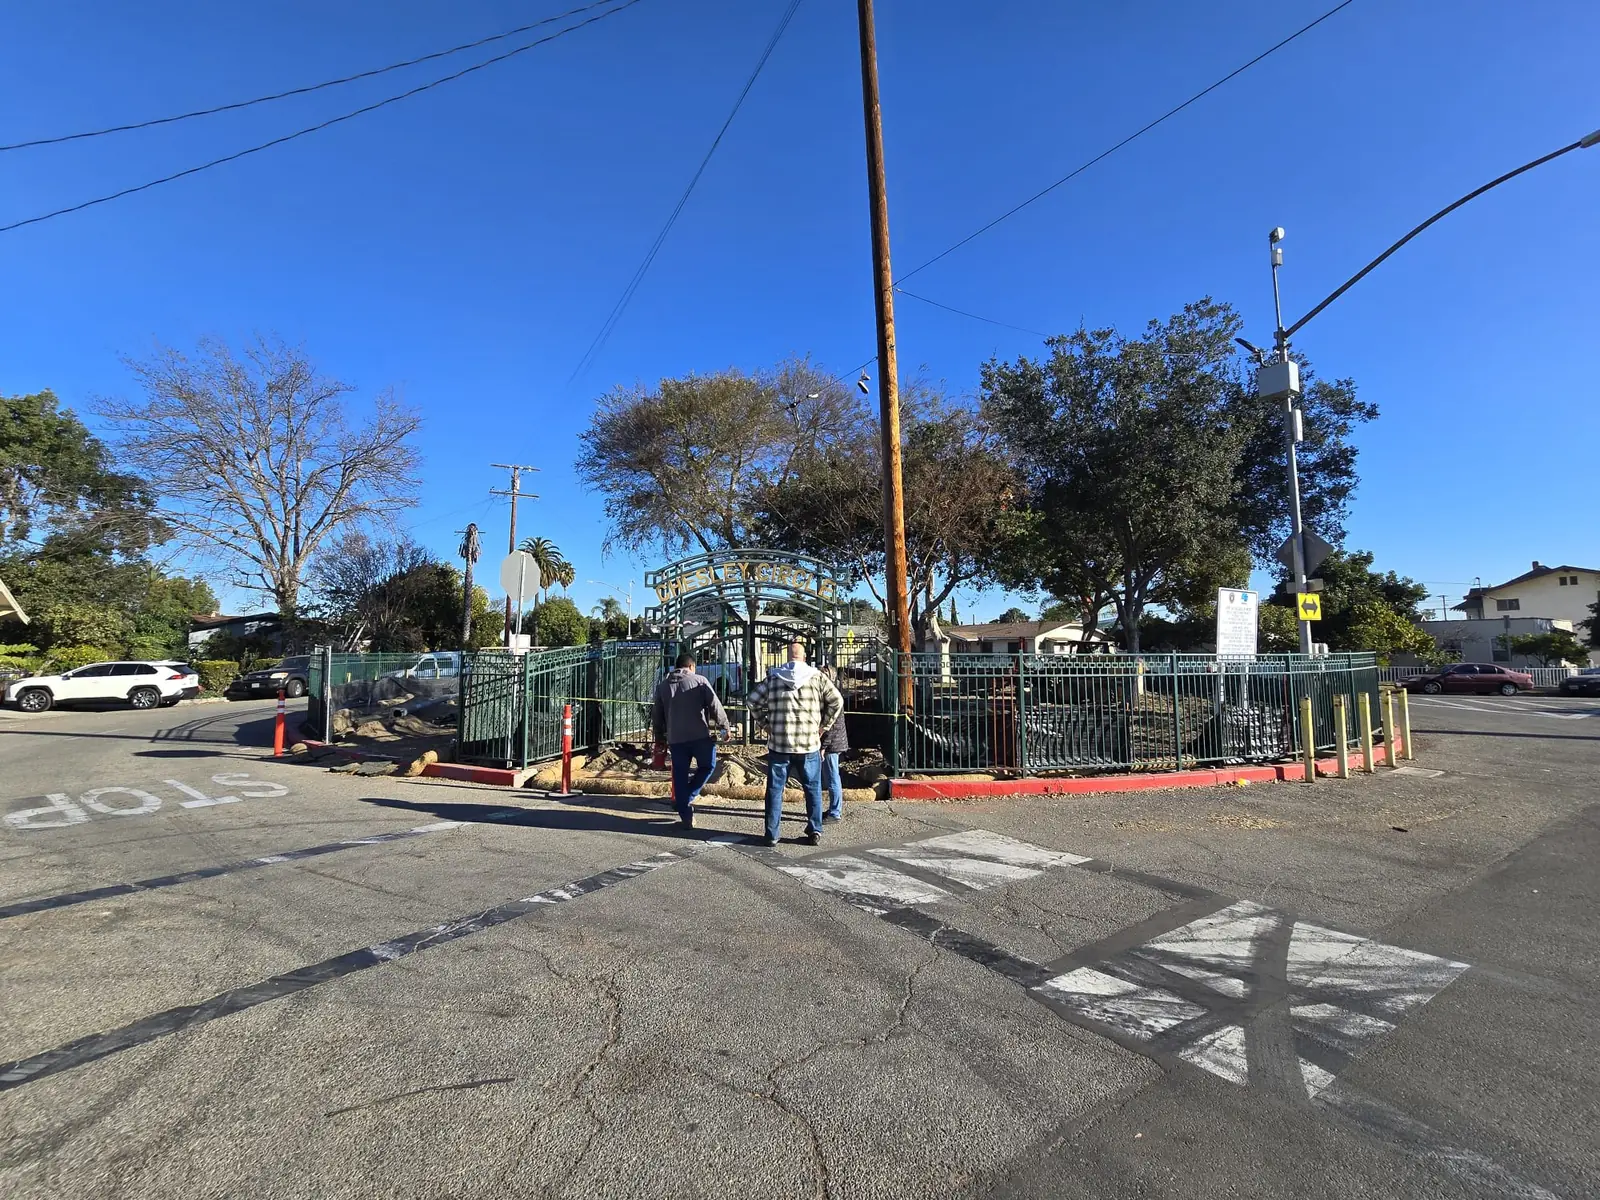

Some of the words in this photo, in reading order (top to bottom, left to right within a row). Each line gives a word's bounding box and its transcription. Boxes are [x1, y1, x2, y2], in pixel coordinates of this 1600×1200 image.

[655, 562, 749, 603] CHESLEY
[756, 562, 836, 601] CIRCLE
[2, 772, 290, 829] STOP
